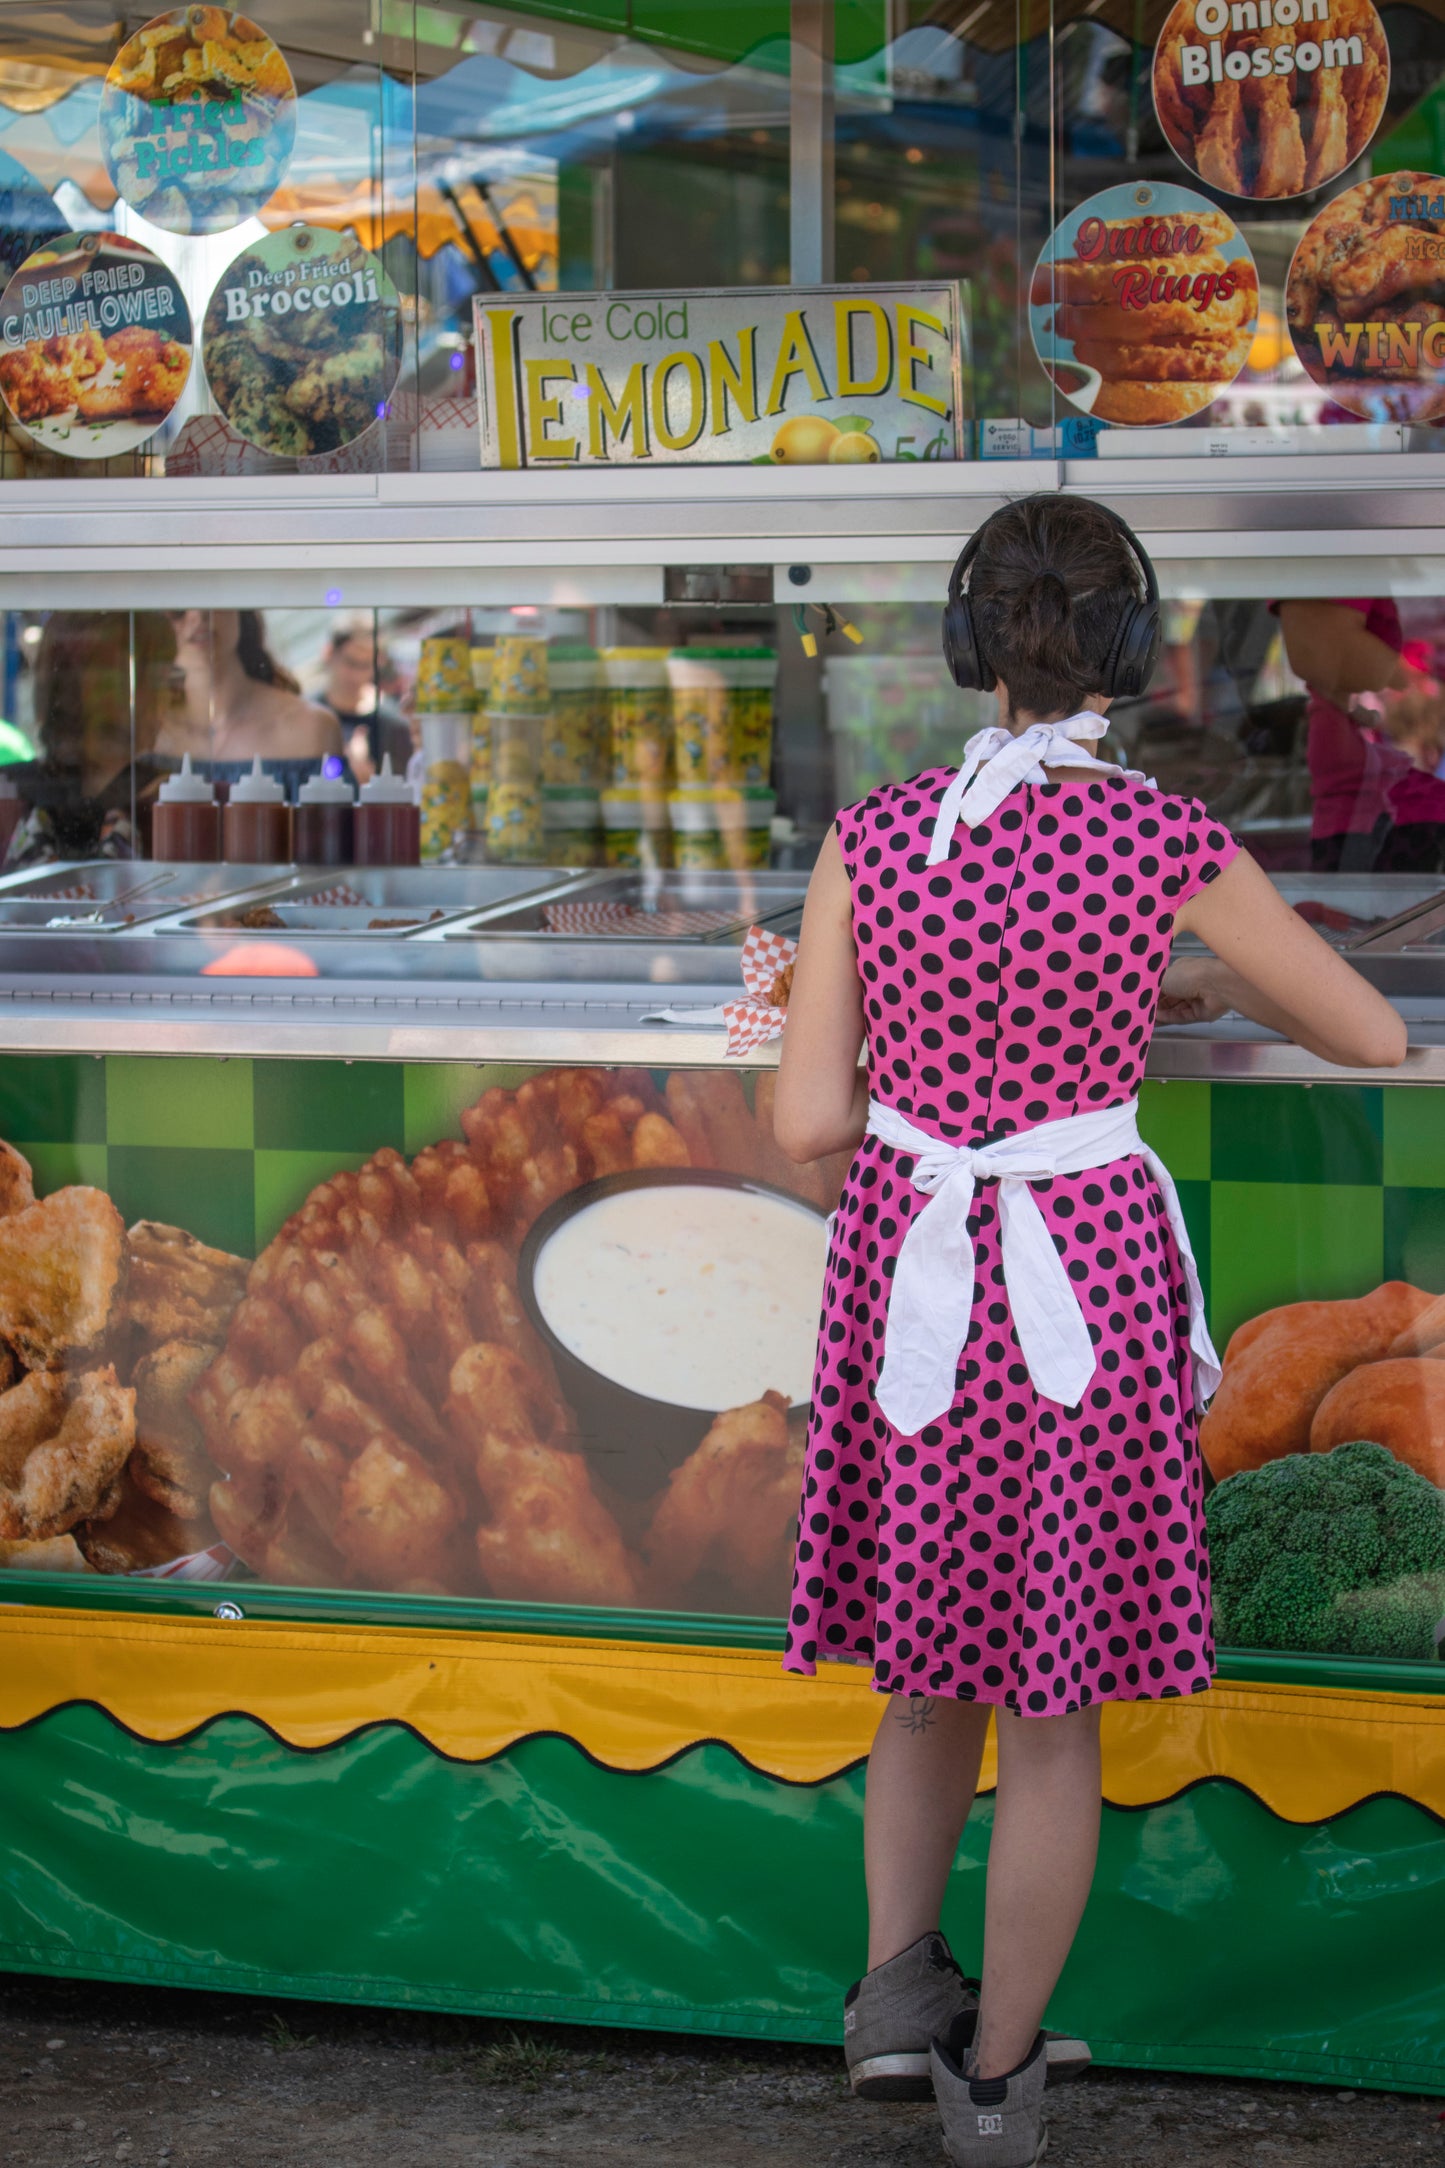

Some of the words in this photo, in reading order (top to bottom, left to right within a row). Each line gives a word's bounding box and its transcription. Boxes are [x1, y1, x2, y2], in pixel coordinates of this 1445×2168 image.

[1195, 0, 1329, 35] Onion
[1181, 34, 1363, 86] Blossom
[150, 89, 246, 135] Fried
[134, 135, 265, 178] Pickles
[1389, 193, 1445, 220] Mild
[1077, 216, 1202, 261] Onion
[22, 278, 77, 308] DEEP
[81, 263, 145, 296] FRIED
[224, 269, 379, 322] Broccoli
[248, 268, 296, 289] Deep
[300, 259, 352, 280] Fried
[1112, 265, 1236, 312] Rings
[3, 286, 175, 347] CAULIFLOWER
[541, 305, 592, 342] Ice
[606, 302, 688, 340] Cold
[488, 299, 952, 468] LEMONADE
